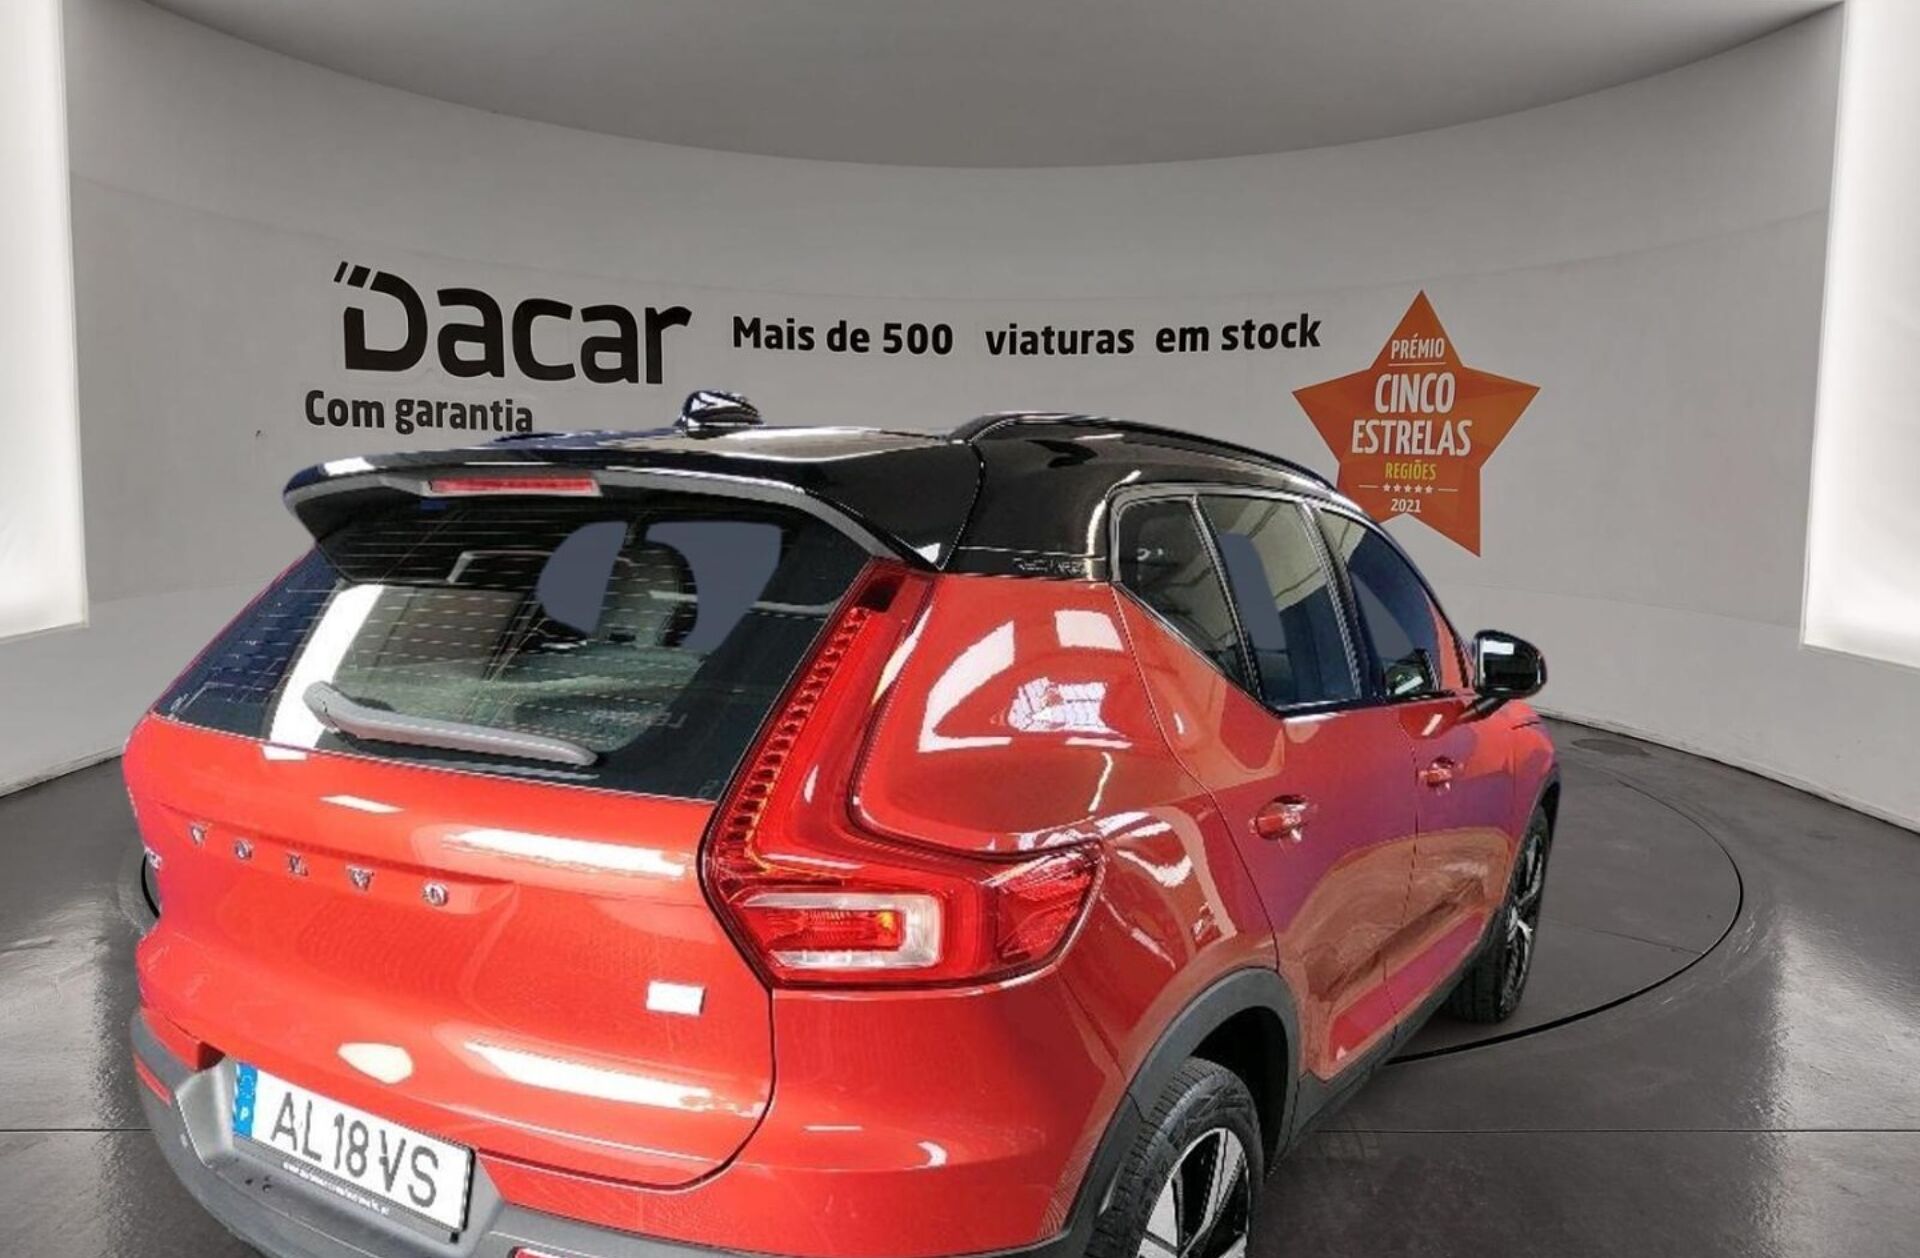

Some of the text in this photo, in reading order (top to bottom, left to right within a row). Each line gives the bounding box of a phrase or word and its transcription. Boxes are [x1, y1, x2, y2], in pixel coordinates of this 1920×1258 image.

[333, 261, 692, 384] Dacar
[732, 313, 1322, 355] Mais de 500 viaturas em stock
[1390, 333, 1445, 360] PRÉMIO
[305, 390, 534, 434] Com garantia
[1374, 372, 1456, 414] CINCO
[1351, 419, 1473, 457] ESTRELAS
[1384, 459, 1437, 480] REGIÕES
[1390, 498, 1422, 513] 2021
